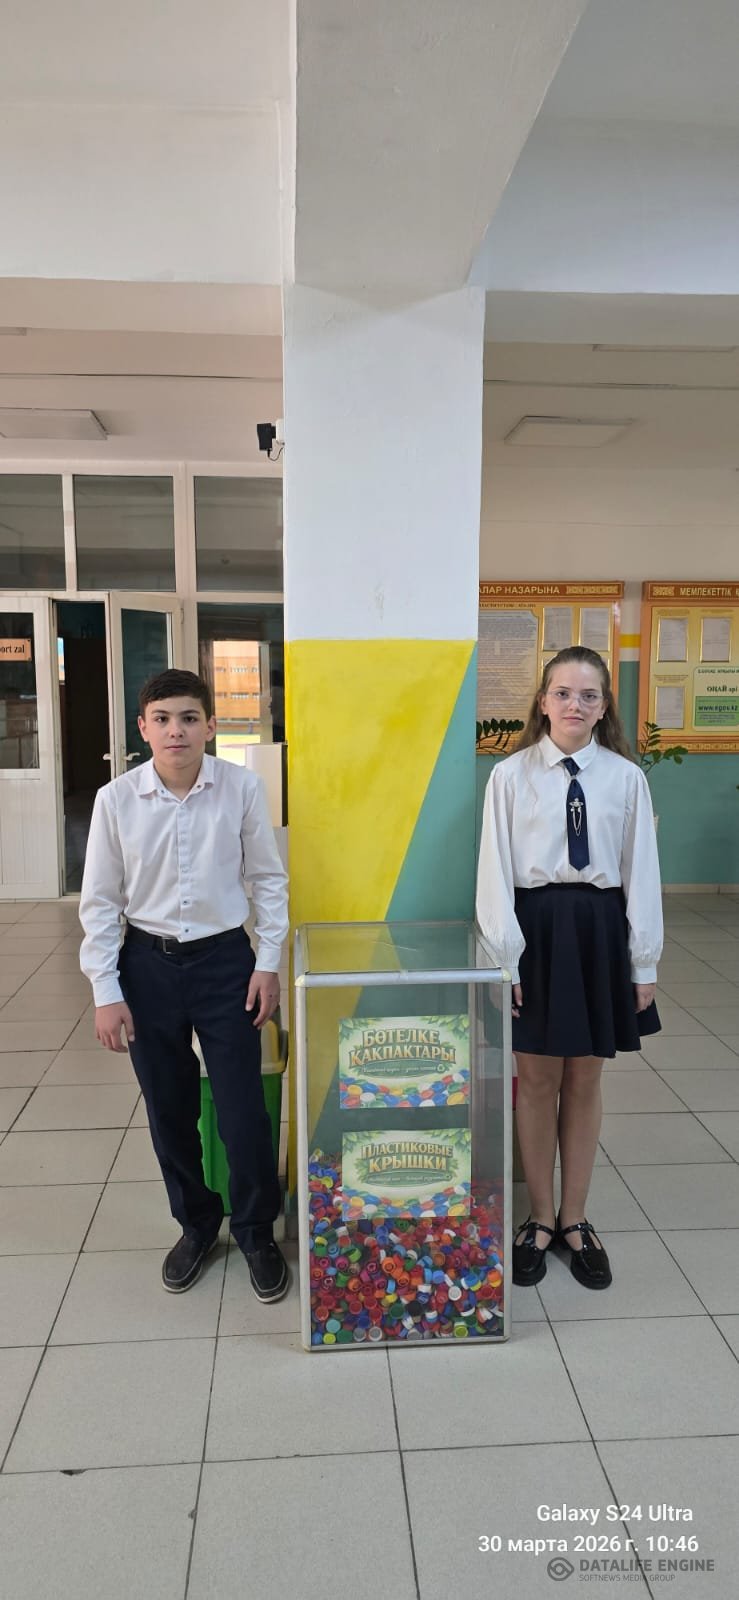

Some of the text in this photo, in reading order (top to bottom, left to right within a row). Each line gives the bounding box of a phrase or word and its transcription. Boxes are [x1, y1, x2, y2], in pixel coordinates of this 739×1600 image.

[505, 586, 560, 594] НАЗАРЫНА
[14, 645, 25, 653] zal
[363, 1029, 439, 1047] БӨТЕЛКЕ
[362, 1142, 453, 1158] ПЛАСТИКОВЫЕ
[369, 1155, 447, 1172] КРЫШКИ
